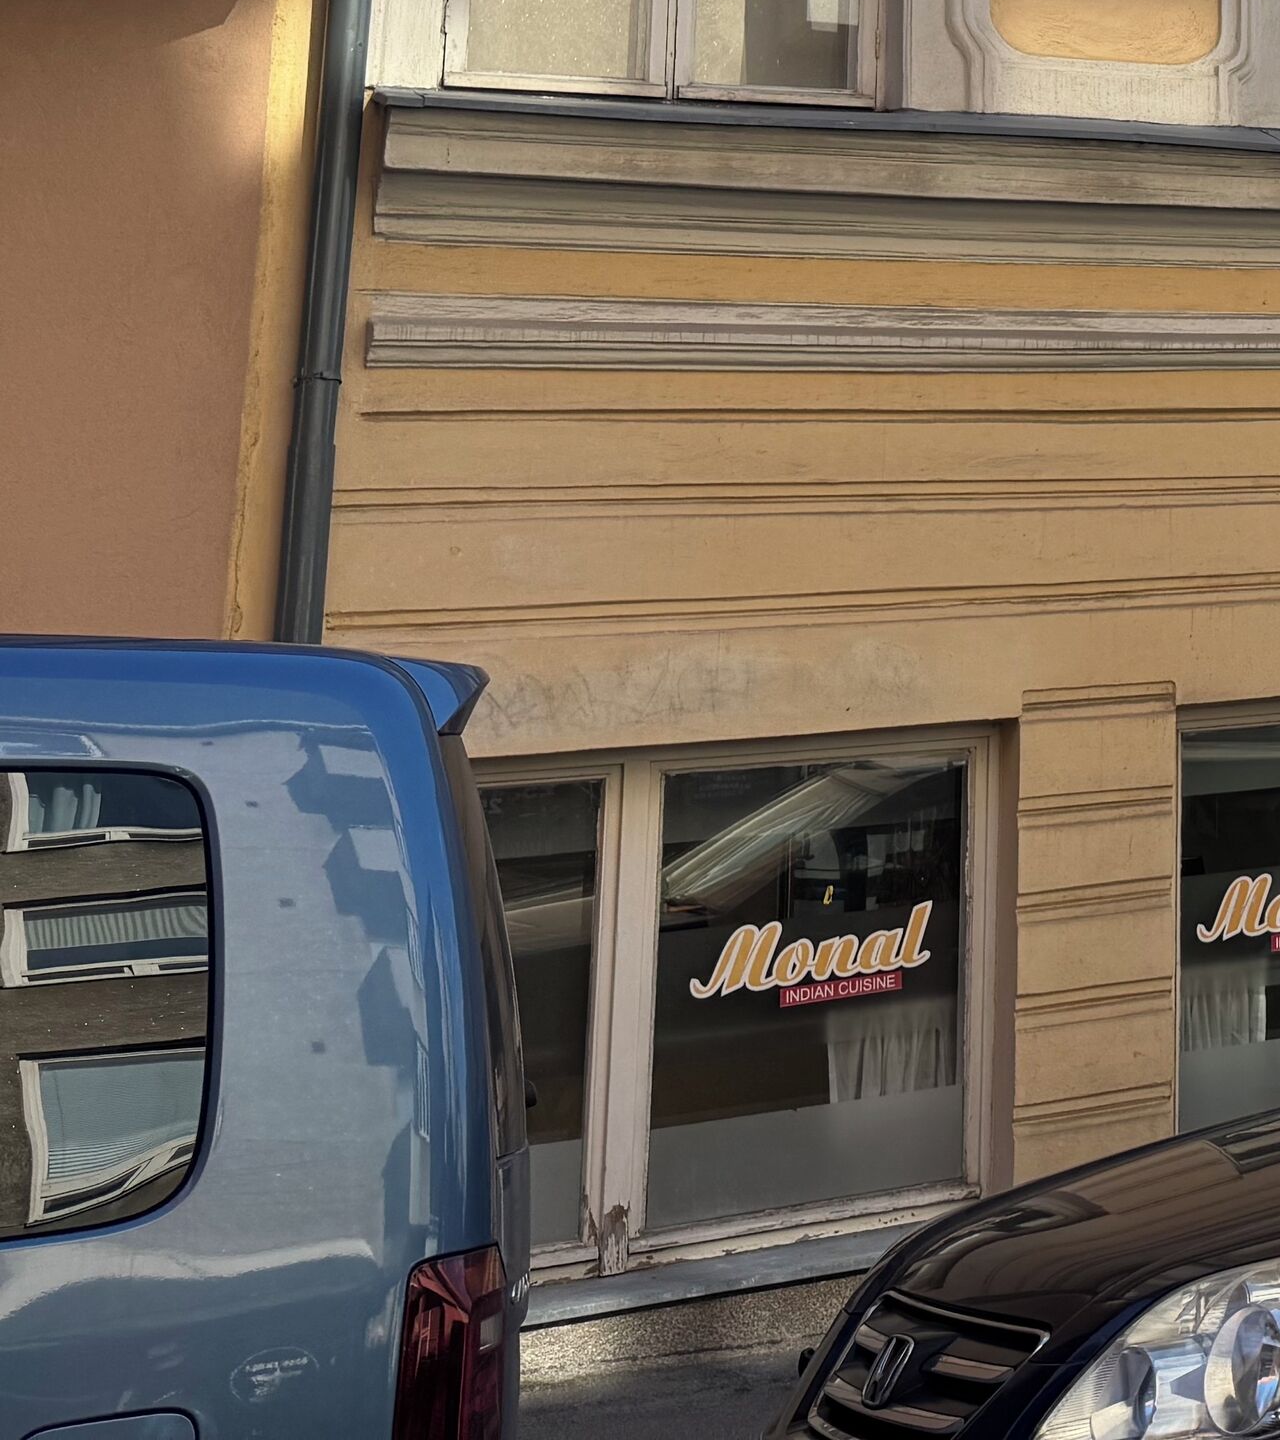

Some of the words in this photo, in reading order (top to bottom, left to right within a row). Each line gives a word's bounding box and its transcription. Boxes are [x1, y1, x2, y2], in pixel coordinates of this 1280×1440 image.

[689, 900, 933, 999] Monal
[785, 983, 836, 1004] INDIAN
[838, 974, 896, 995] CUISINE
